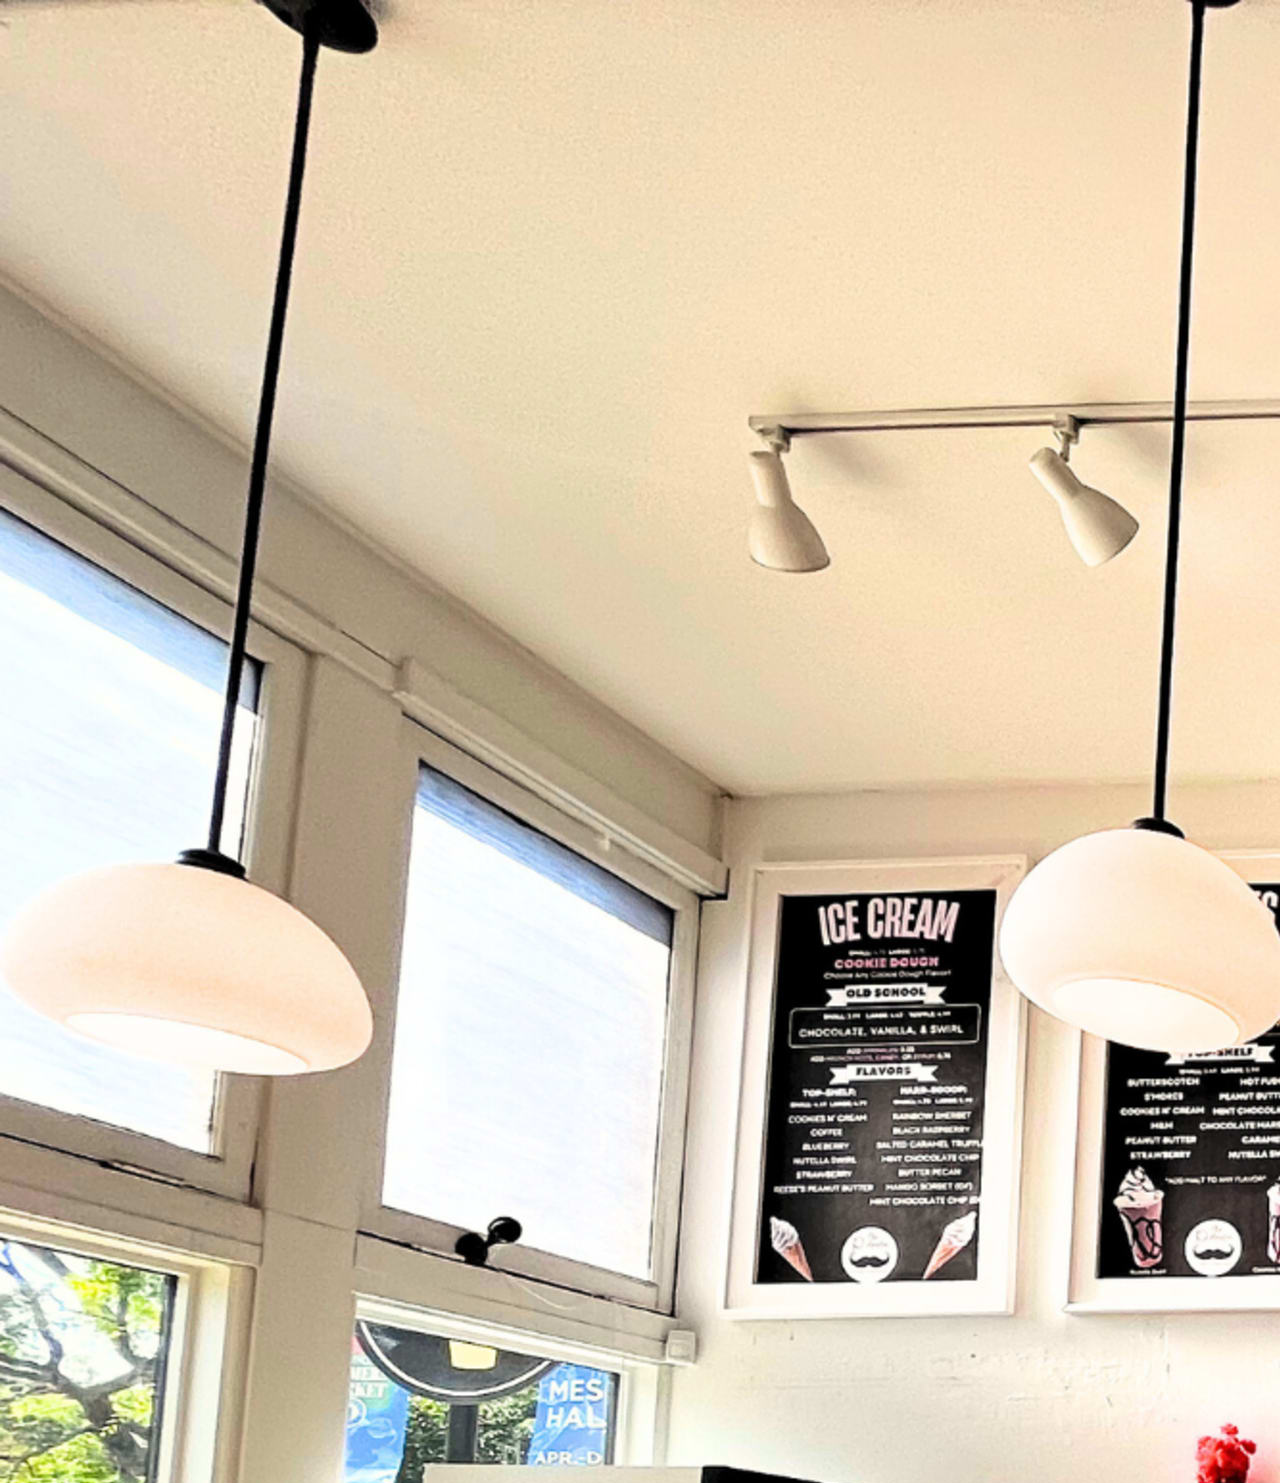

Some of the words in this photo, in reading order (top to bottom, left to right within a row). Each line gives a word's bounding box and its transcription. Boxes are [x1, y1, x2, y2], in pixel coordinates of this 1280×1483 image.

[818, 900, 861, 946] ICE
[868, 897, 960, 943] CREAM
[834, 958, 886, 968] COOKIE
[890, 957, 939, 967] DOUGH
[846, 989, 871, 998] OLD
[875, 987, 925, 997] SCHOOL
[930, 1025, 963, 1033] SWIRL
[856, 1067, 912, 1076] FLAVORS
[1127, 1078, 1200, 1086] BUTTERSCOTCH
[1219, 1092, 1253, 1100] PEANUT
[1120, 1107, 1160, 1116] COOKIES
[1173, 1107, 1205, 1115] CREAM
[788, 1115, 825, 1123] COOKIES
[837, 1114, 867, 1122] CREAM
[893, 1127, 920, 1135] BLACK
